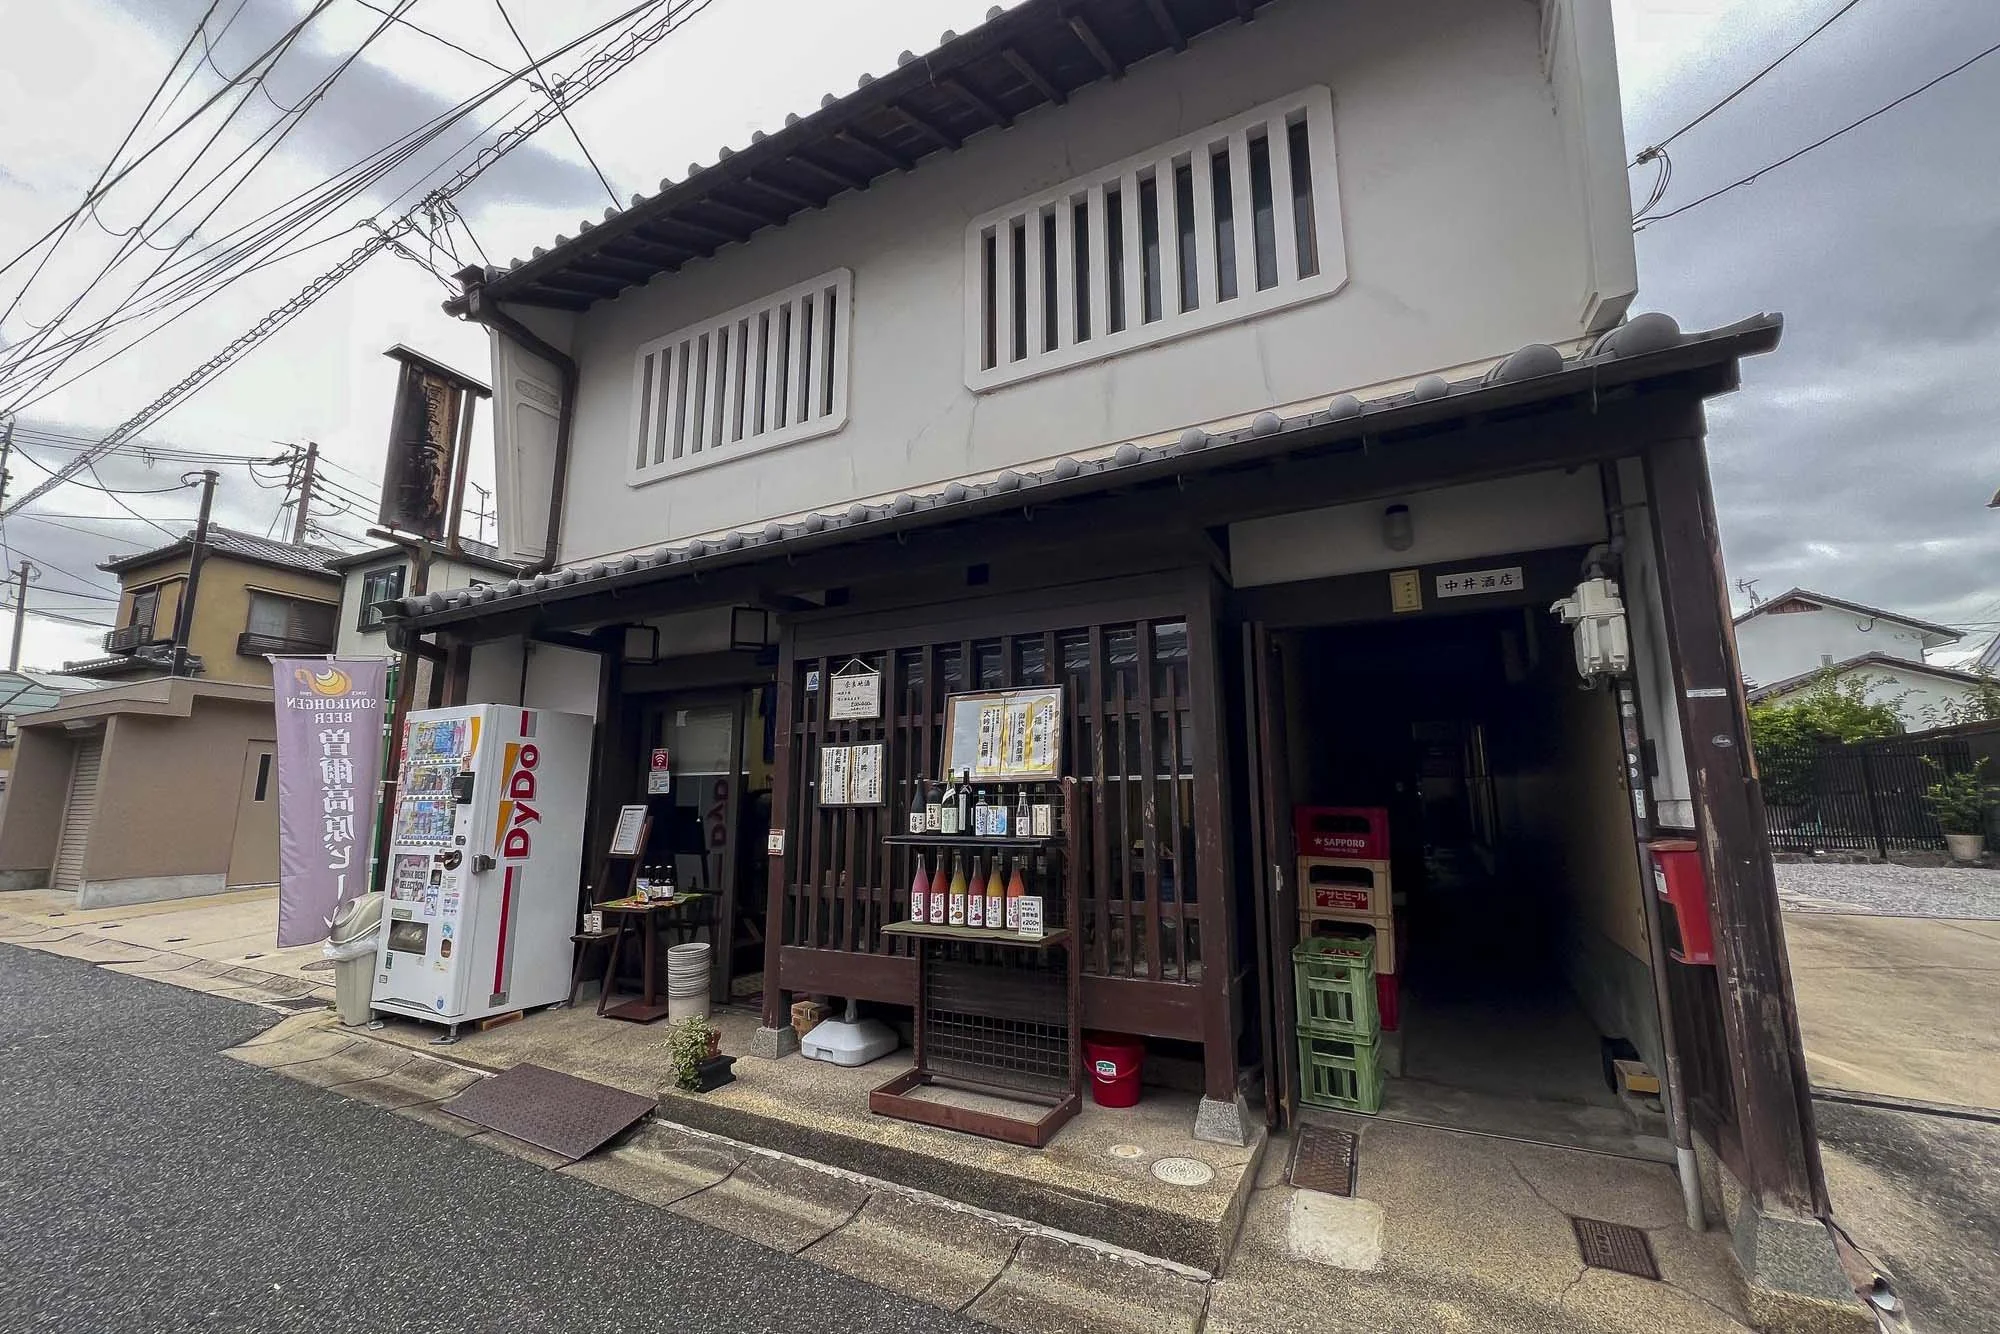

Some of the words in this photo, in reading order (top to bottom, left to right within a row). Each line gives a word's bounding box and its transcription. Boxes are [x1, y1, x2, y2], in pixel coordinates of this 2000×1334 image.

[1444, 573, 1513, 592] 中井酒店
[504, 743, 541, 859] DyDo
[1324, 838, 1365, 848] SAPPORO
[1316, 889, 1367, 902] アサヒビール
